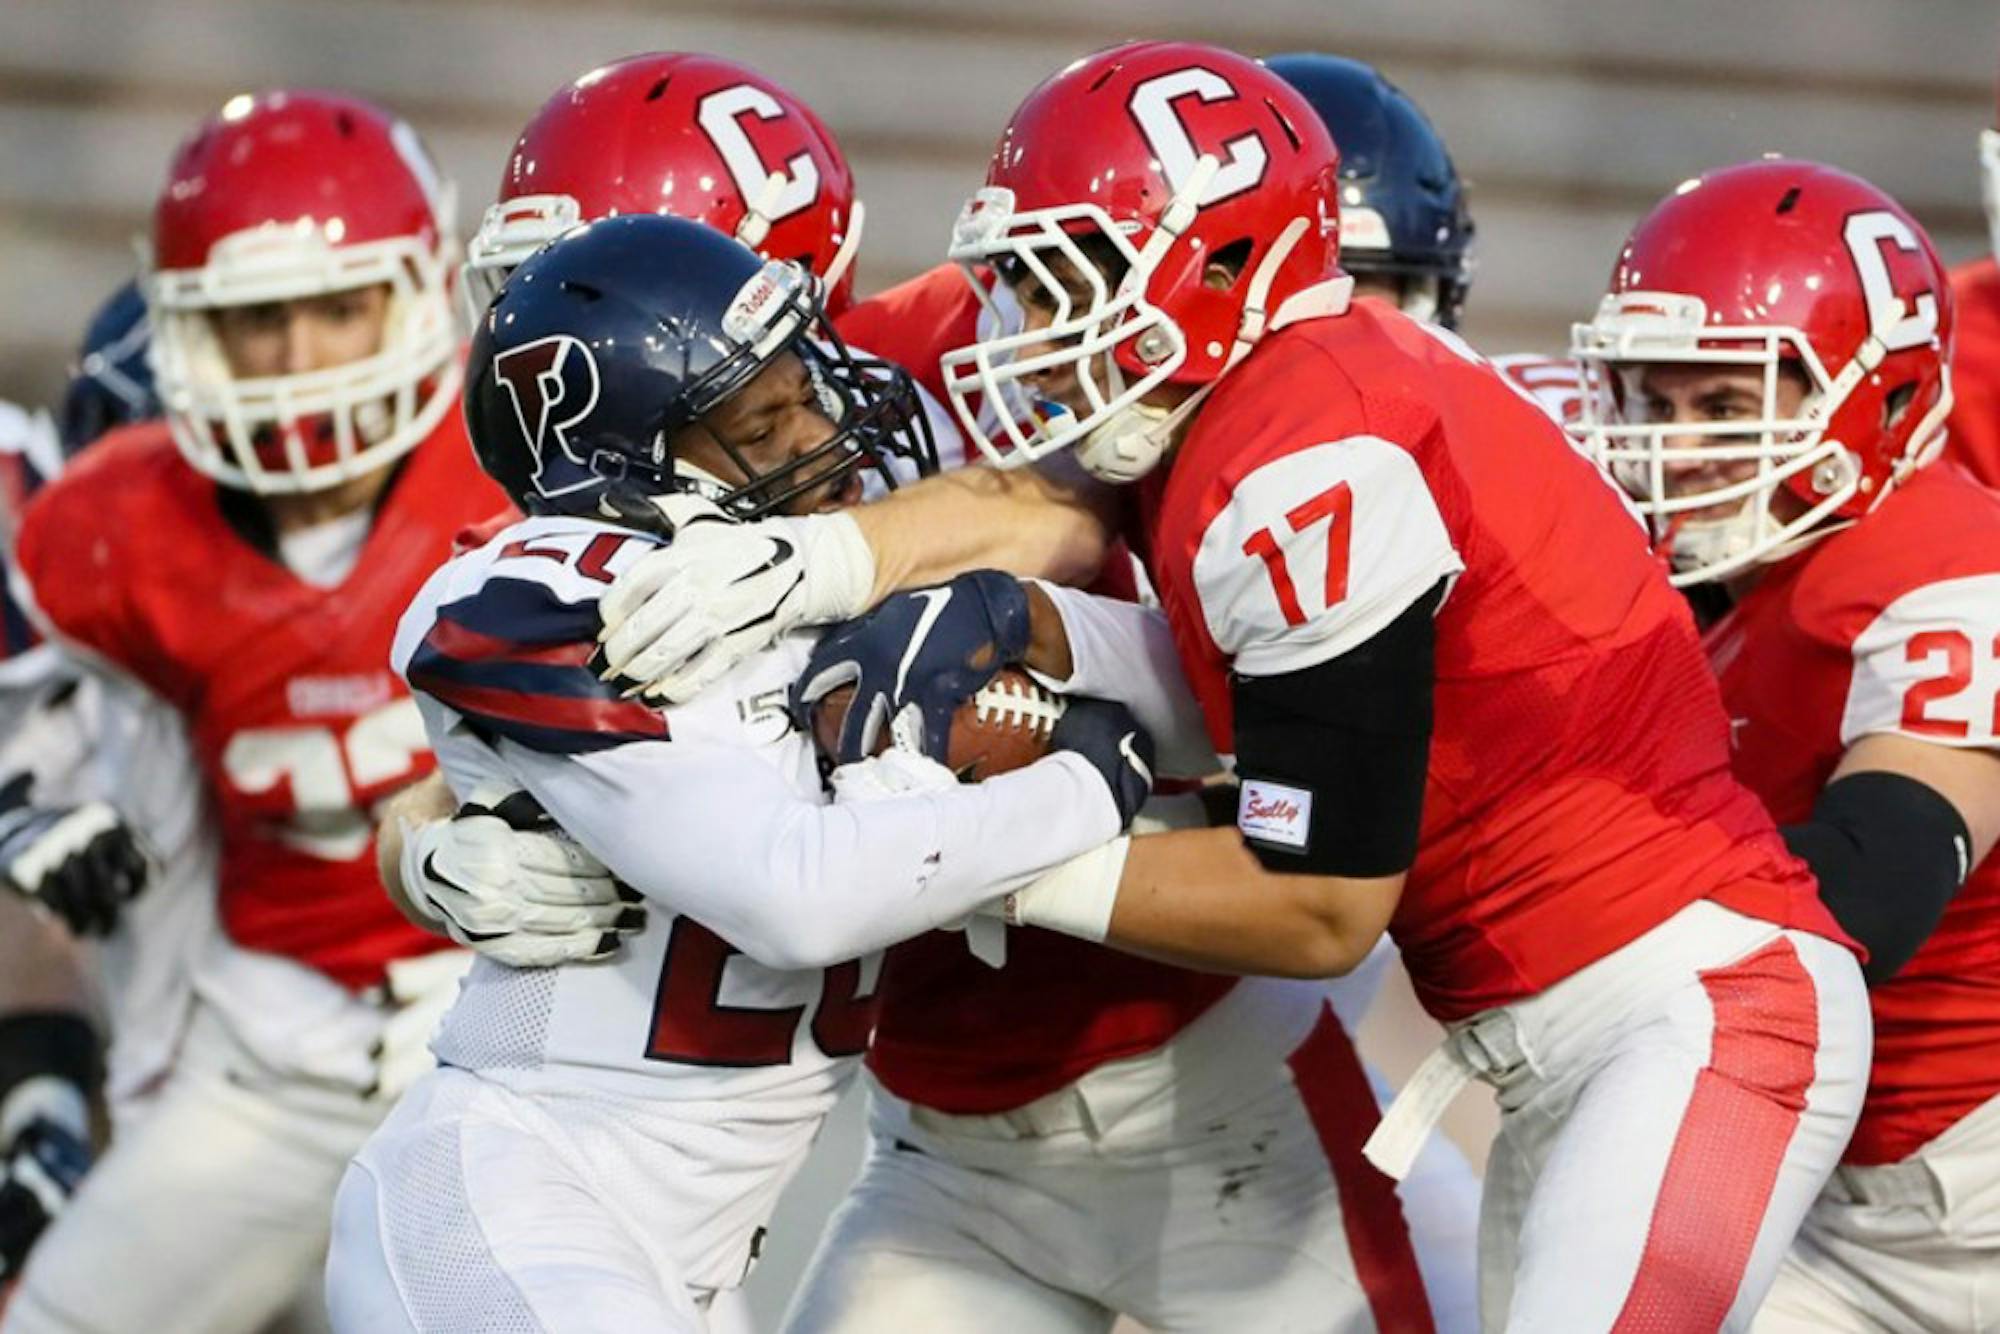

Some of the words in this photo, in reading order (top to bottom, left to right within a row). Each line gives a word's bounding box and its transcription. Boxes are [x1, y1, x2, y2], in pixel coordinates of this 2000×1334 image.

[697, 84, 820, 223] C
[1129, 66, 1269, 209] C
[1843, 211, 1940, 353] C
[493, 335, 606, 498] P
[1242, 480, 1353, 627] 17
[1900, 629, 2000, 738] 2
